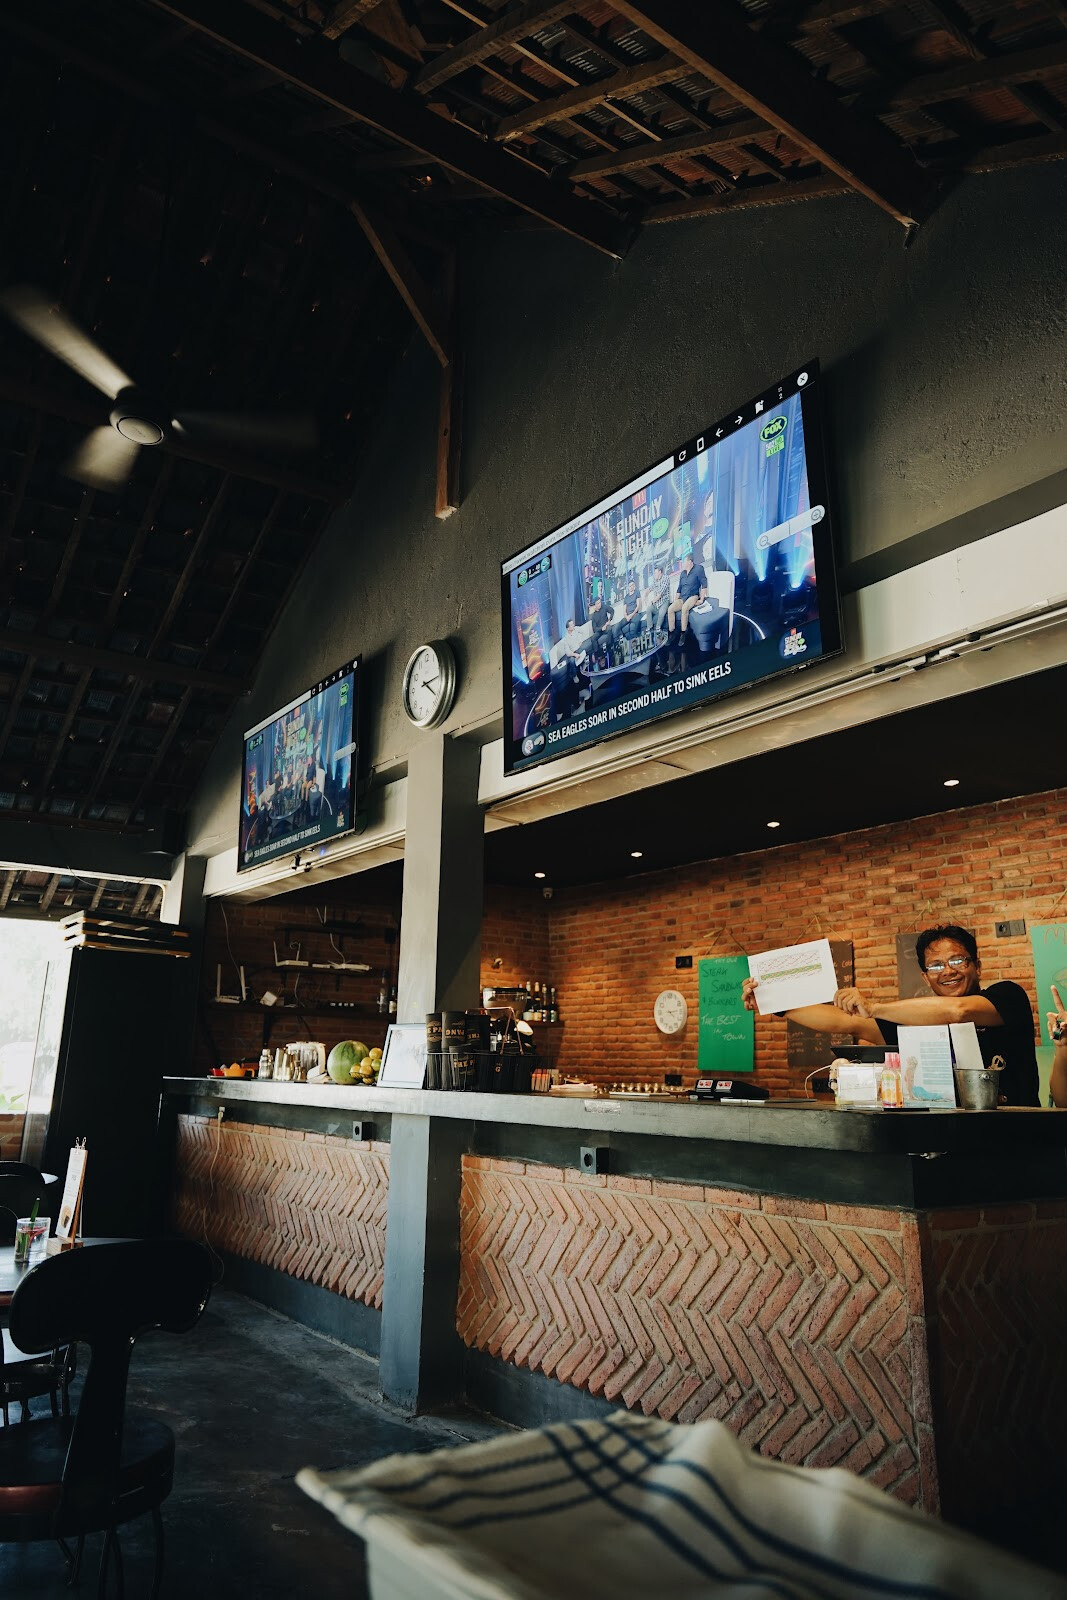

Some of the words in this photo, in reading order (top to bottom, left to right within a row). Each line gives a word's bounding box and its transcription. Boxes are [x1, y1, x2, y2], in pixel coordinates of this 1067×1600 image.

[764, 420, 782, 438] FOX
[617, 495, 662, 537] SUNDAY
[548, 731, 561, 743] SEA
[562, 719, 588, 738] EAGLES
[588, 710, 608, 728] SOAR
[608, 708, 617, 720] IN
[618, 694, 650, 717] SECOND
[651, 685, 672, 704] HALF
[673, 679, 685, 694] TO
[685, 670, 708, 690] SINK
[708, 661, 732, 681] EELS
[716, 1014, 742, 1025] BEST
